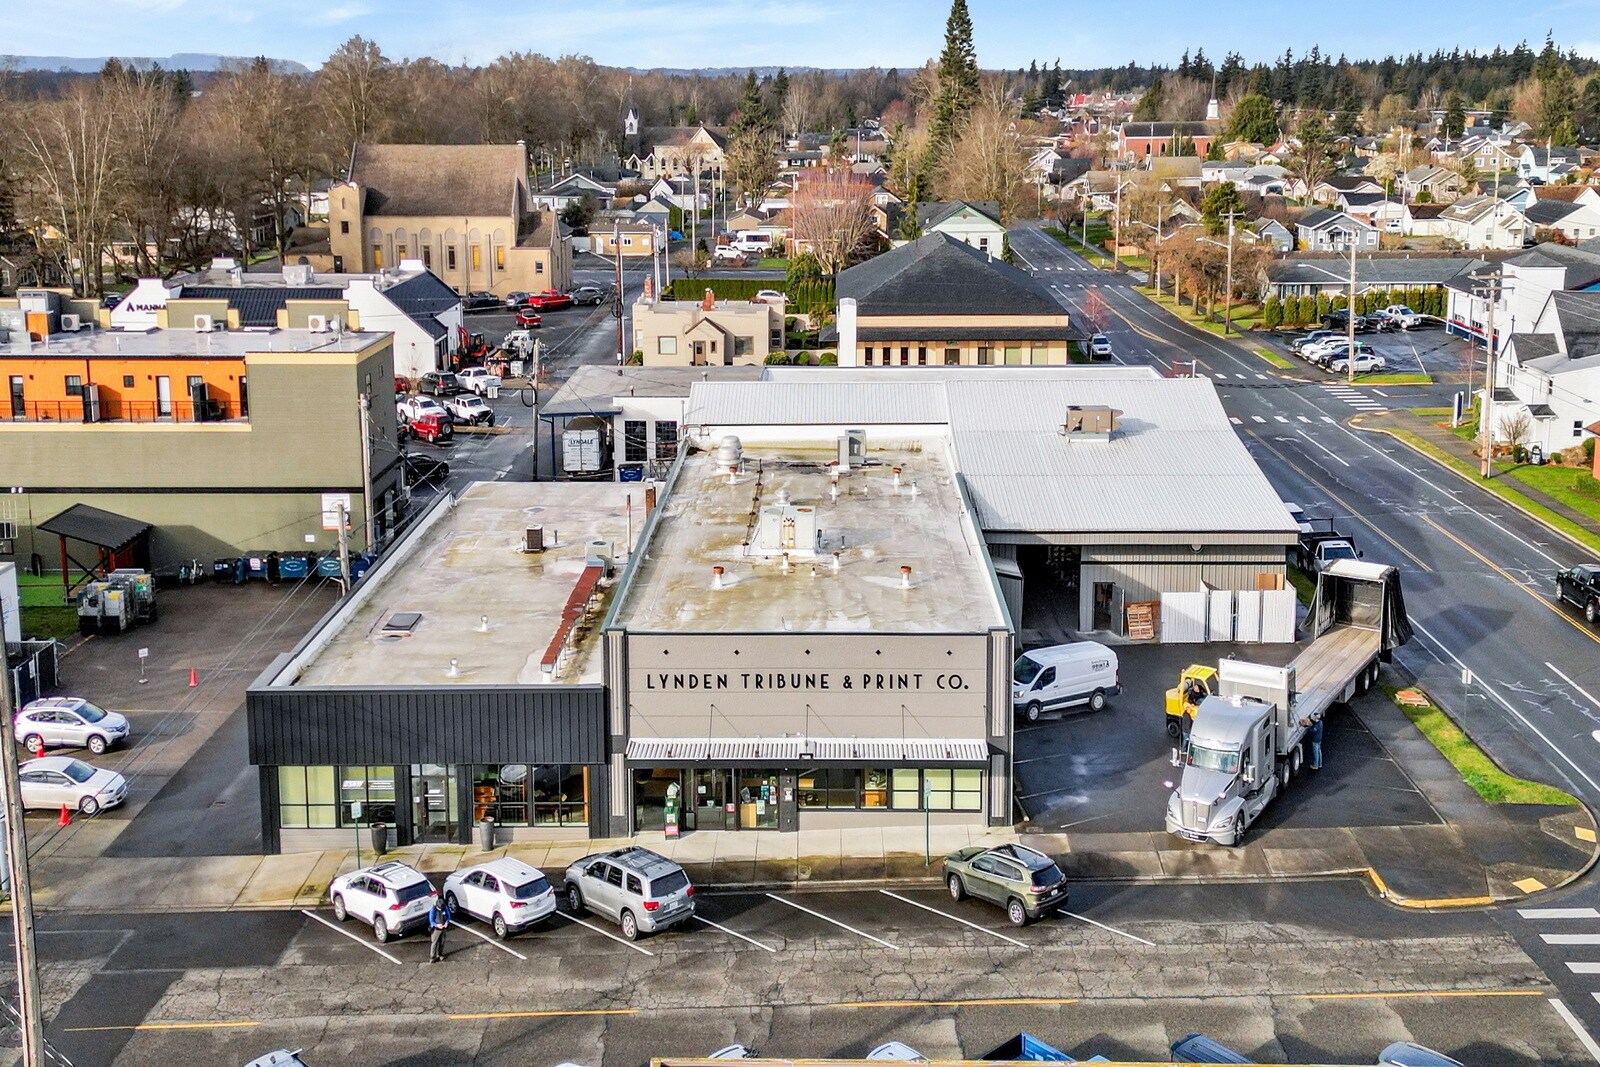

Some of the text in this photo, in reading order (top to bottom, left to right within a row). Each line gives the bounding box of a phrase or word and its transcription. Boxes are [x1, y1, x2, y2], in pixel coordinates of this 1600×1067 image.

[647, 673, 969, 689] LYNDEN TRIBUNE & PRINT CO.
